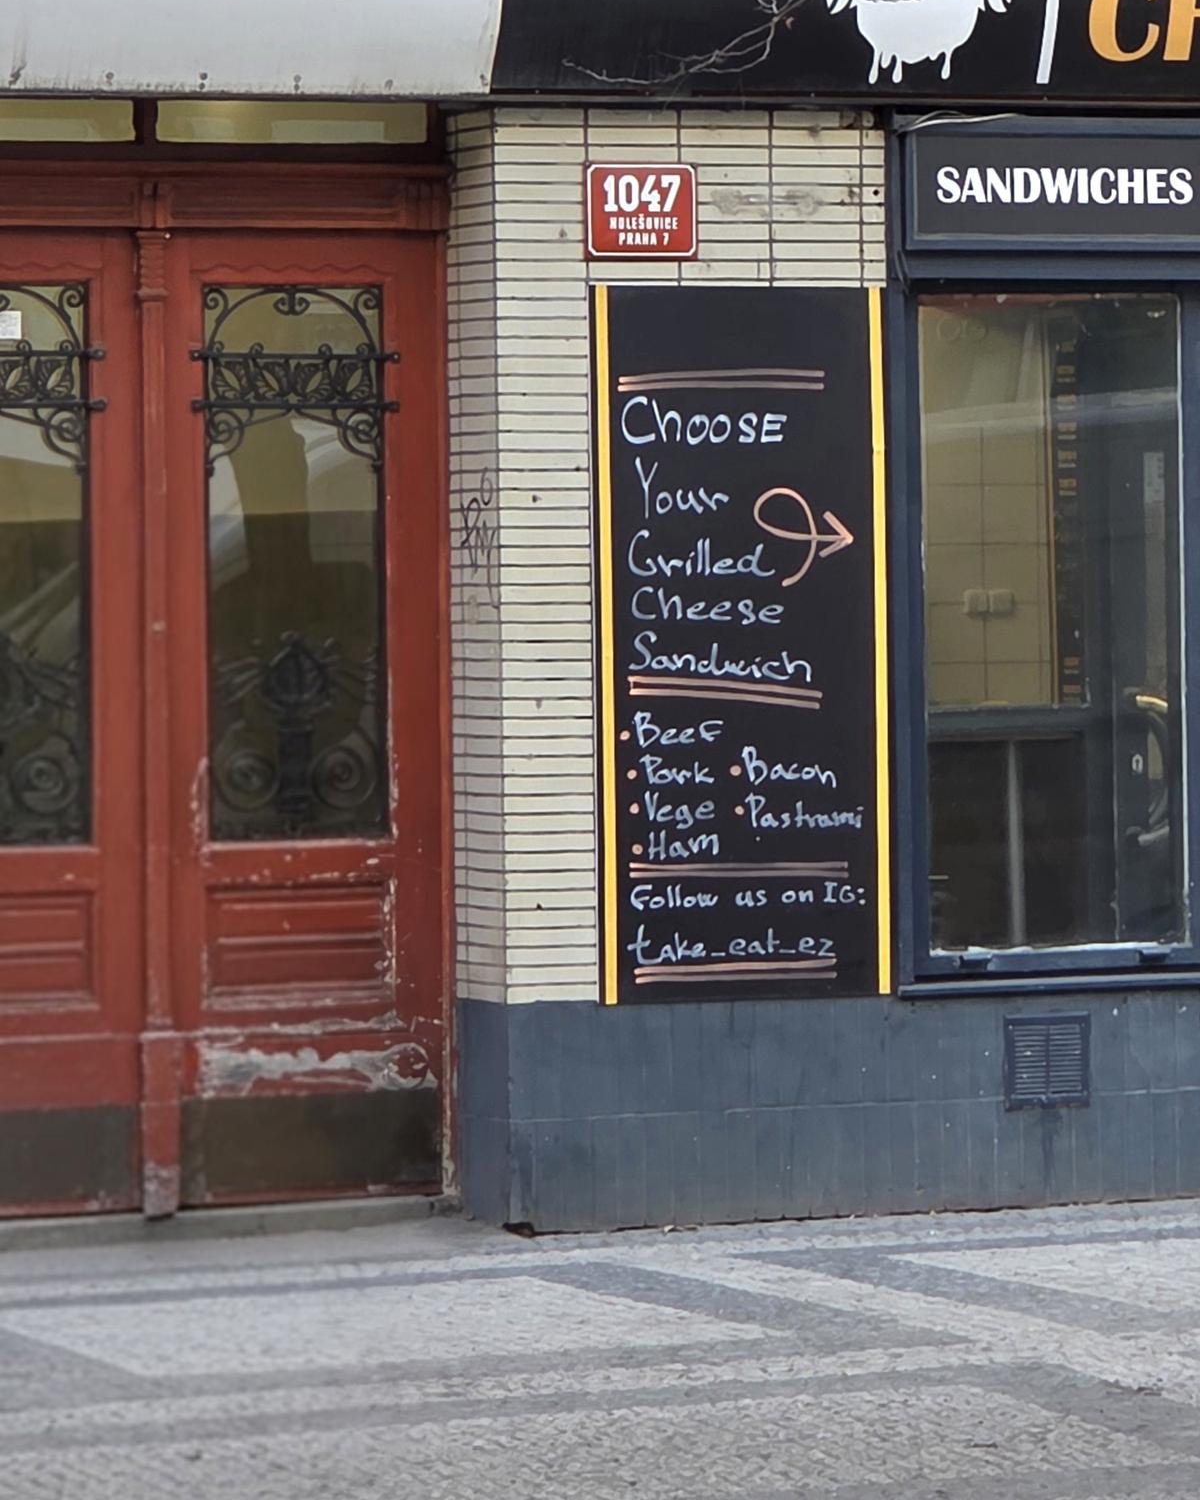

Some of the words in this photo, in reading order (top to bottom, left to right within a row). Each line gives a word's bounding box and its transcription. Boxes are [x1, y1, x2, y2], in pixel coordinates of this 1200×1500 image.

[603, 174, 681, 213] 1047
[936, 166, 1193, 204] SANDWICHES
[609, 213, 679, 230] HOLEŠOVICE
[618, 231, 657, 246] PRAHA
[662, 231, 670, 246] 7
[634, 456, 731, 519] Your
[627, 529, 776, 578] Grilled
[630, 586, 785, 626] Cheese
[626, 629, 815, 684] Sandwich
[638, 753, 716, 786] Pork
[741, 745, 837, 790] Bacon
[643, 791, 717, 831] Vege
[744, 791, 865, 830] Pastrami
[647, 831, 720, 863] Ham
[629, 882, 719, 911] Follow
[735, 885, 768, 908] us
[780, 885, 815, 906] on
[823, 880, 867, 906] IG:
